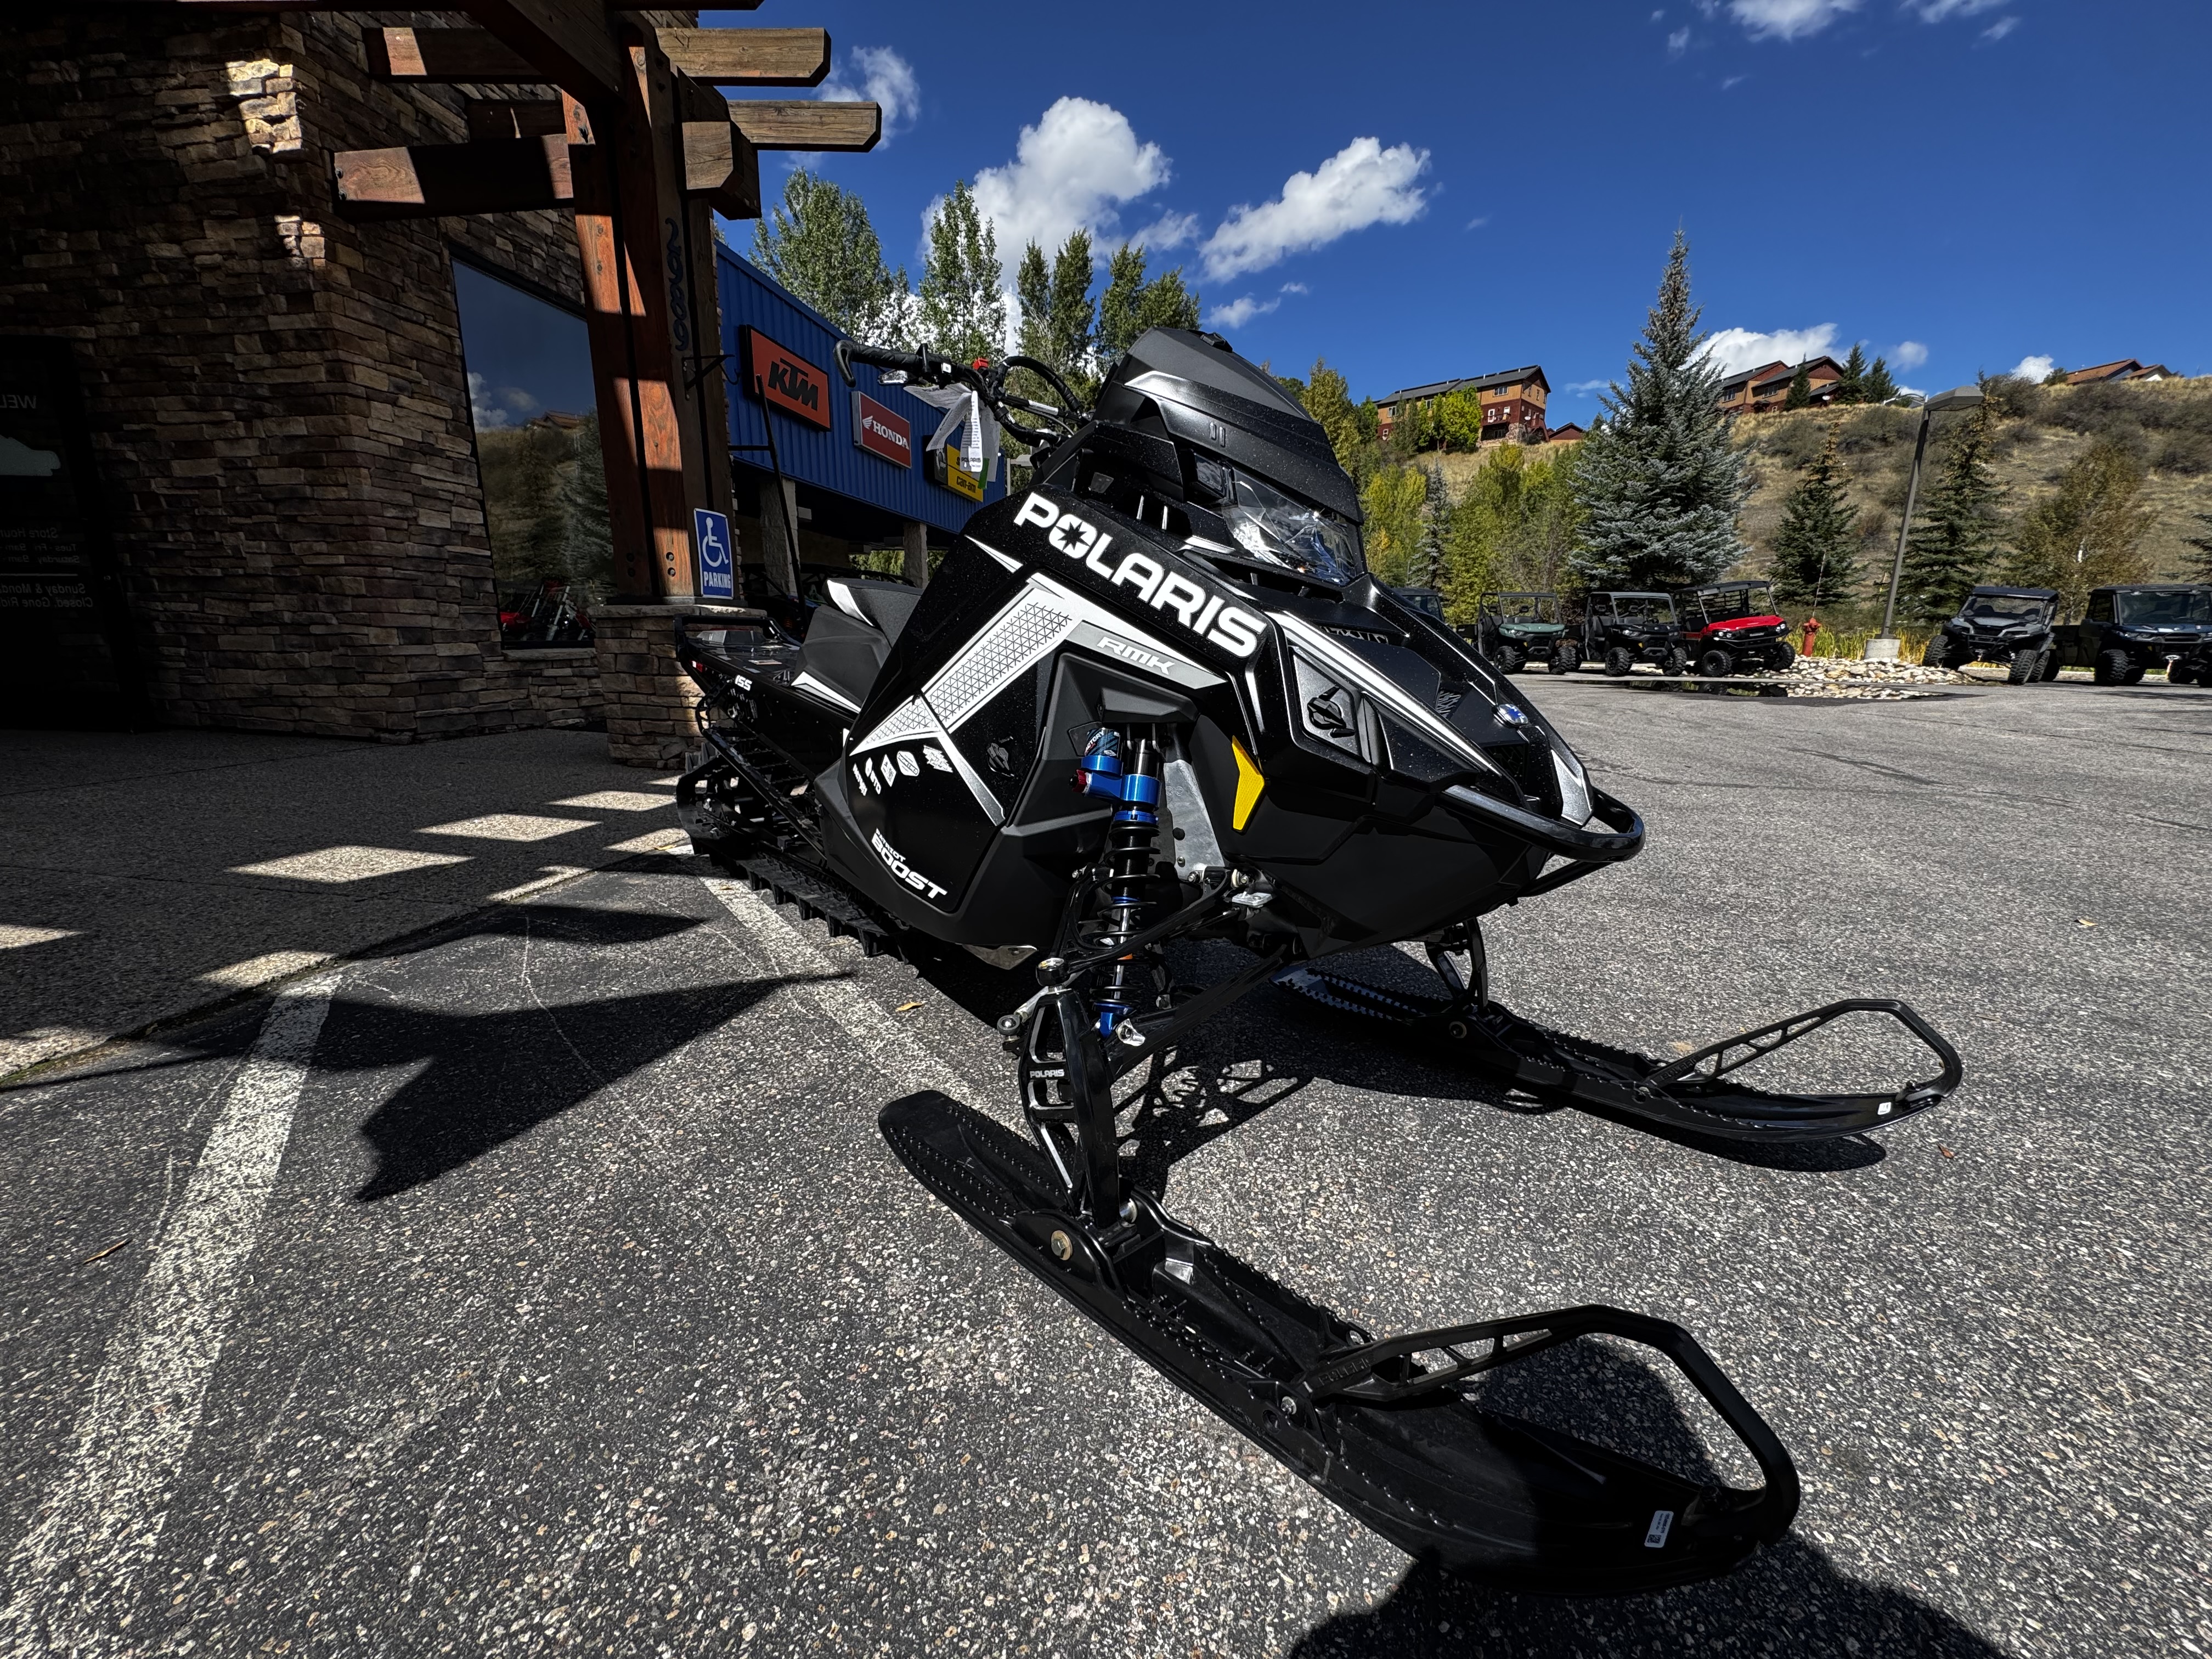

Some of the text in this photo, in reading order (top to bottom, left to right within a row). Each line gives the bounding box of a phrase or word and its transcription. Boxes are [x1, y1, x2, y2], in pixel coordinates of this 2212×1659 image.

[768, 358, 818, 411] KTM
[872, 420, 909, 450] HONDA
[703, 571, 731, 589] PARKING
[1013, 492, 1267, 658] POLARIS
[1097, 636, 1178, 676] RMK
[735, 675, 752, 691] 155
[876, 827, 906, 862] PATRIOT
[871, 832, 948, 899] BOOST
[1029, 1069, 1064, 1078] POLARIS
